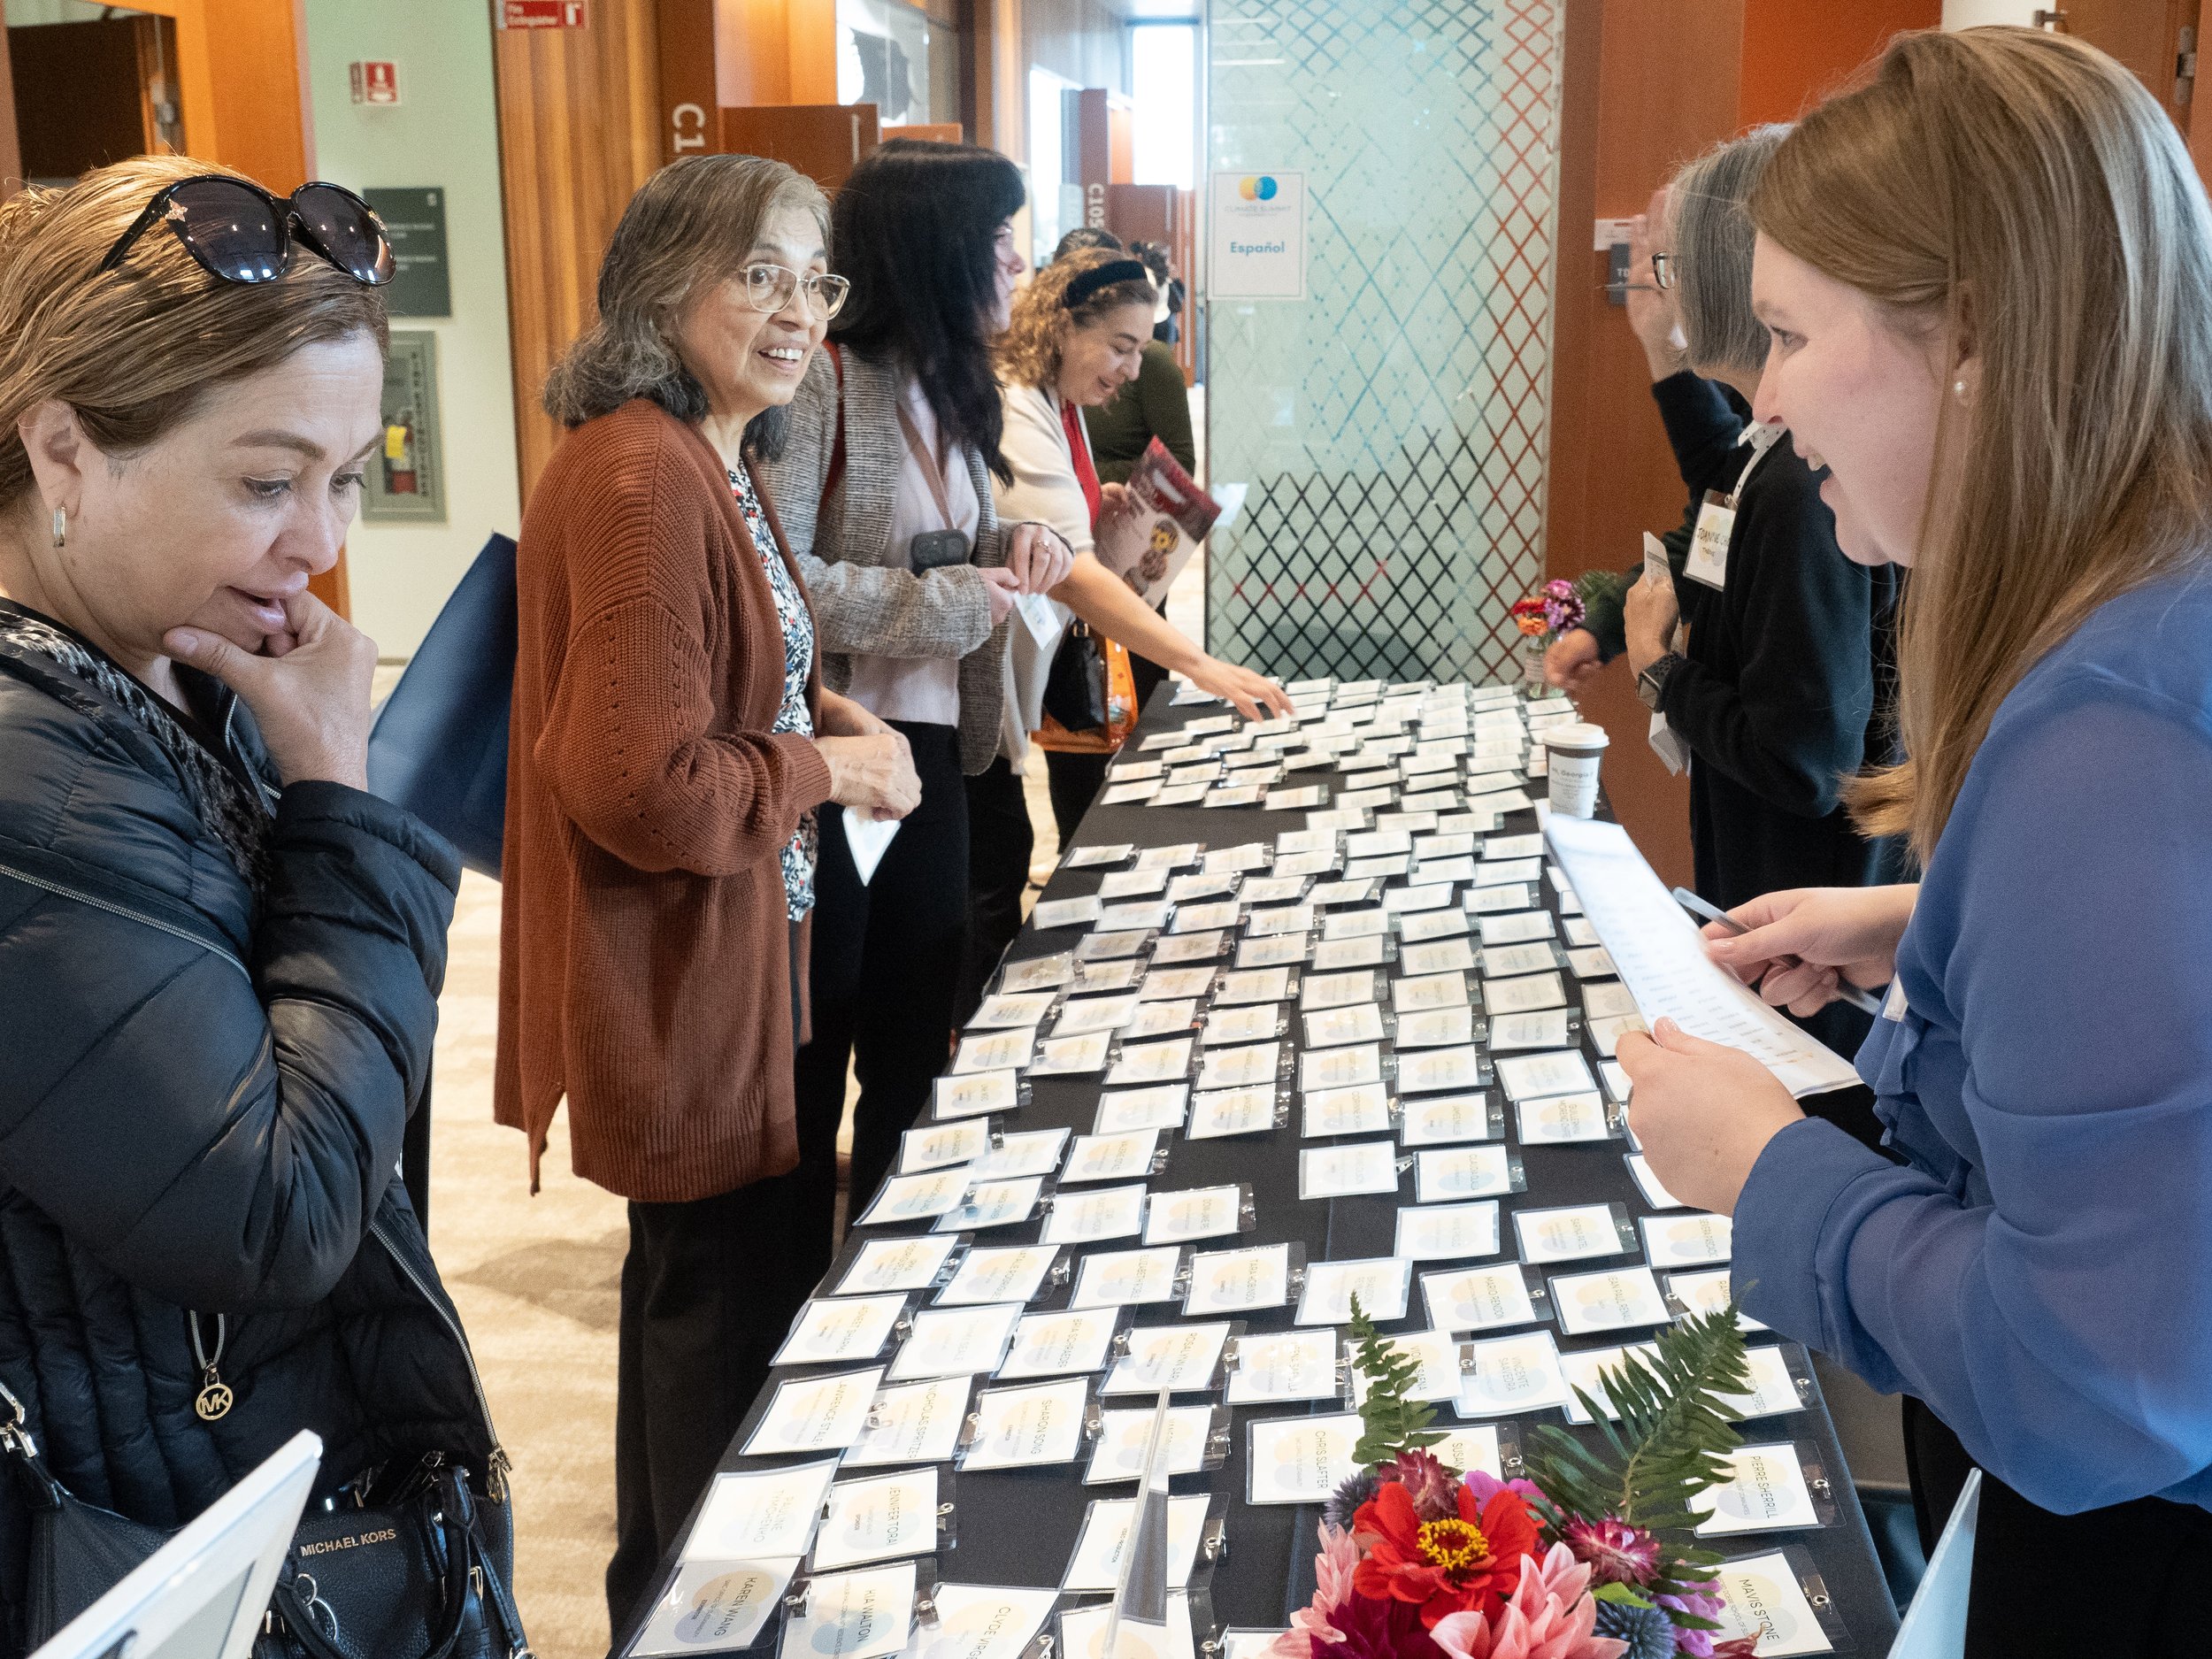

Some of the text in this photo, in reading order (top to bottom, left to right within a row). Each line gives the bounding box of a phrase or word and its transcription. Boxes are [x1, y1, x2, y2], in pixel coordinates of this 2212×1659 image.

[1230, 241, 1286, 257] Español
[917, 1384, 939, 1425] NICHOLAS
[1030, 1400, 1052, 1455] SHARON SONG
[1316, 1431, 1329, 1489] CHRIS SLAFTER
[1452, 1442, 1465, 1468] SUSAN
[887, 1486, 902, 1520] JENNIFER
[1749, 1455, 1778, 1519] PIERRE SHERRILL
[300, 1528, 397, 1557] MICHAEL KORS
[1111, 1538, 1125, 1563] PRODUCTION
[714, 1577, 758, 1637] KAREN WANG
[856, 1589, 876, 1642] KIA WALTON
[983, 1607, 1011, 1635] CLYDE
[1729, 1604, 1742, 1622] SCHOOL
[1738, 1578, 1780, 1641] MAVIS STONE
